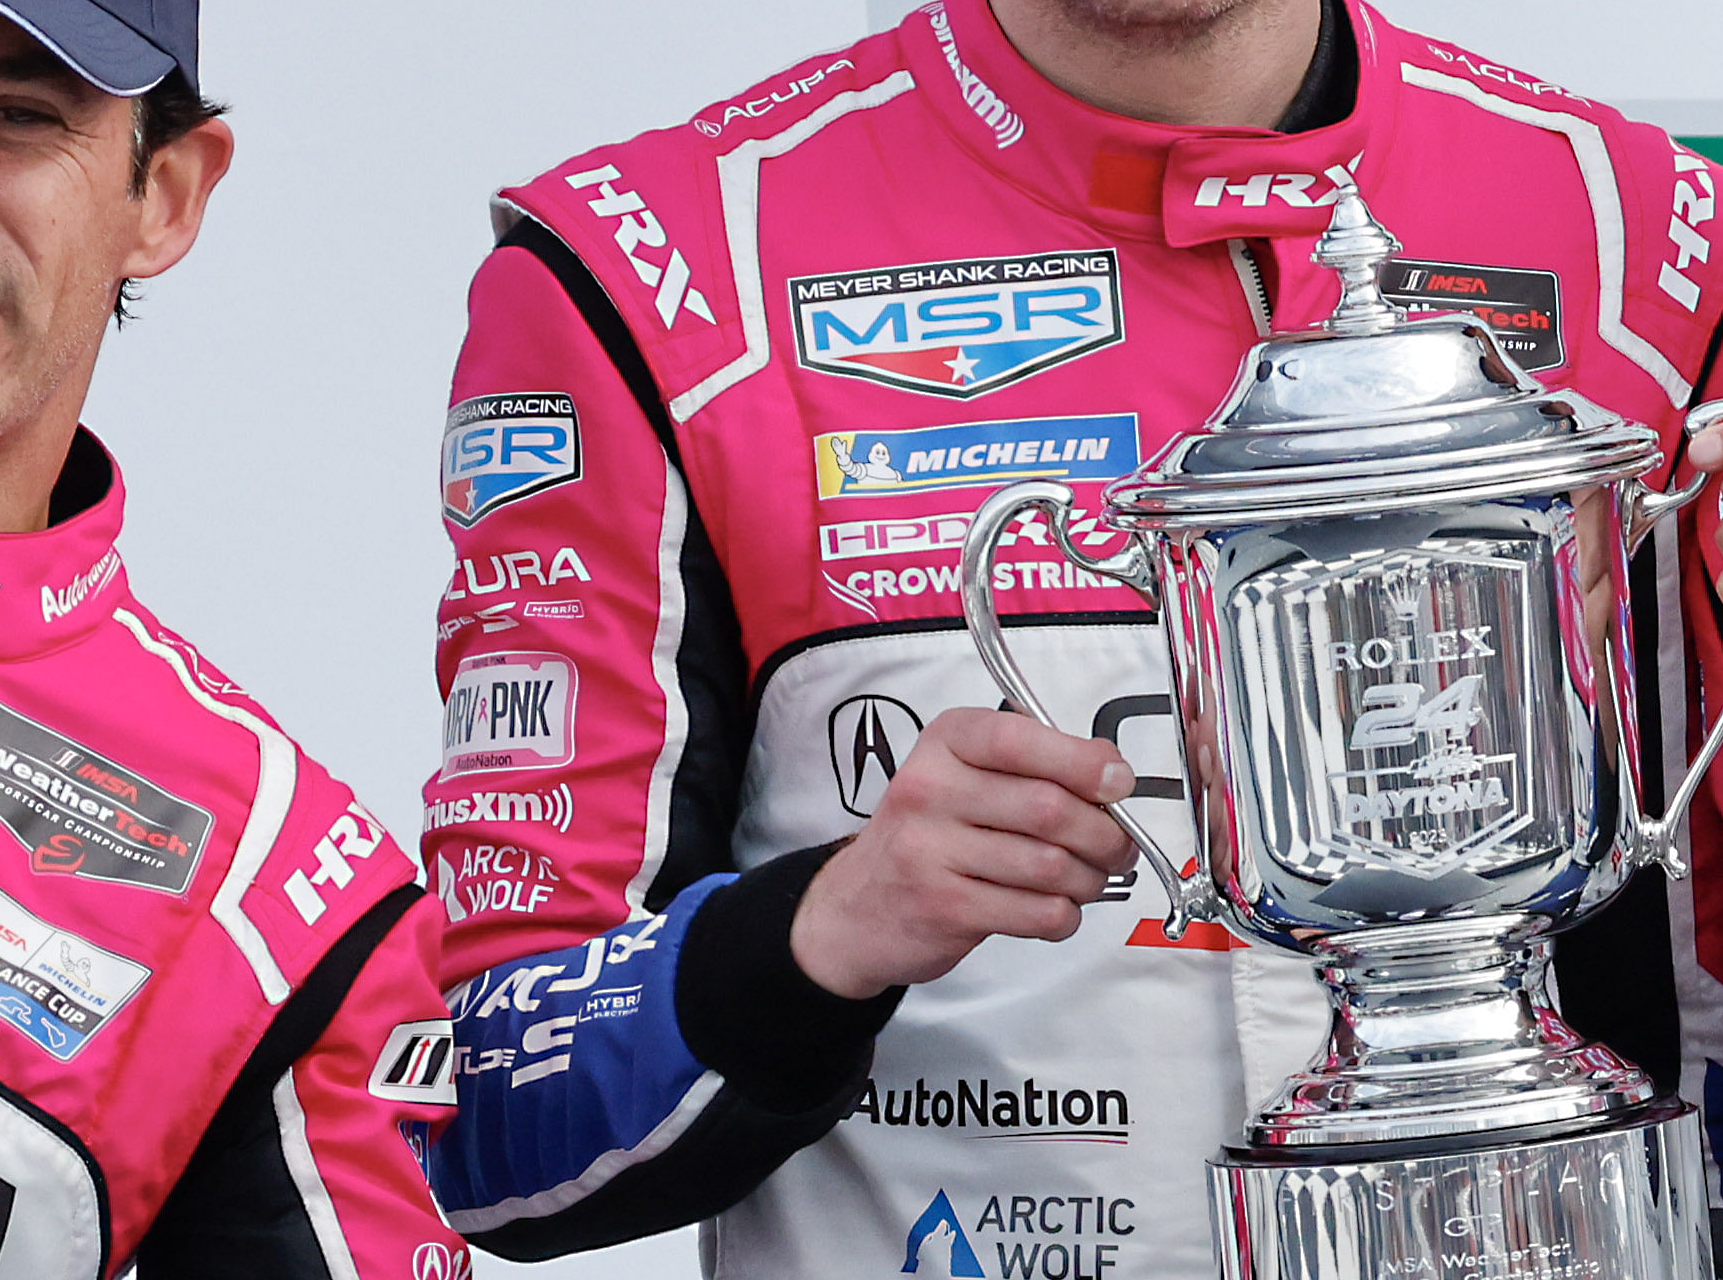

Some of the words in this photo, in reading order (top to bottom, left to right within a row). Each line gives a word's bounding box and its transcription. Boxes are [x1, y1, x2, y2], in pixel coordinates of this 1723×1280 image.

[723, 58, 855, 126] ACURA
[1193, 150, 1366, 207] HRX
[564, 163, 717, 331] HRX
[797, 277, 893, 300] MEYER
[899, 264, 997, 289] SHANK
[1003, 256, 1110, 280] RACING
[1427, 274, 1489, 294] IMSA
[810, 285, 1106, 351] MSR
[500, 399, 573, 415] RACING
[907, 437, 1110, 474] MICHELIN
[828, 518, 970, 554] HPD
[1327, 626, 1496, 672] ROLEX
[490, 680, 554, 740] PNK
[1349, 674, 1485, 751] 24
[76, 763, 140, 804] IMSA
[455, 754, 513, 769] AutoNation
[1344, 776, 1509, 823] DAYTONA
[467, 879, 554, 915] WOLF
[38, 963, 107, 1007] MICHELIN
[851, 1077, 1130, 1129] AutoNation
[976, 1196, 1136, 1236] ARCTIC
